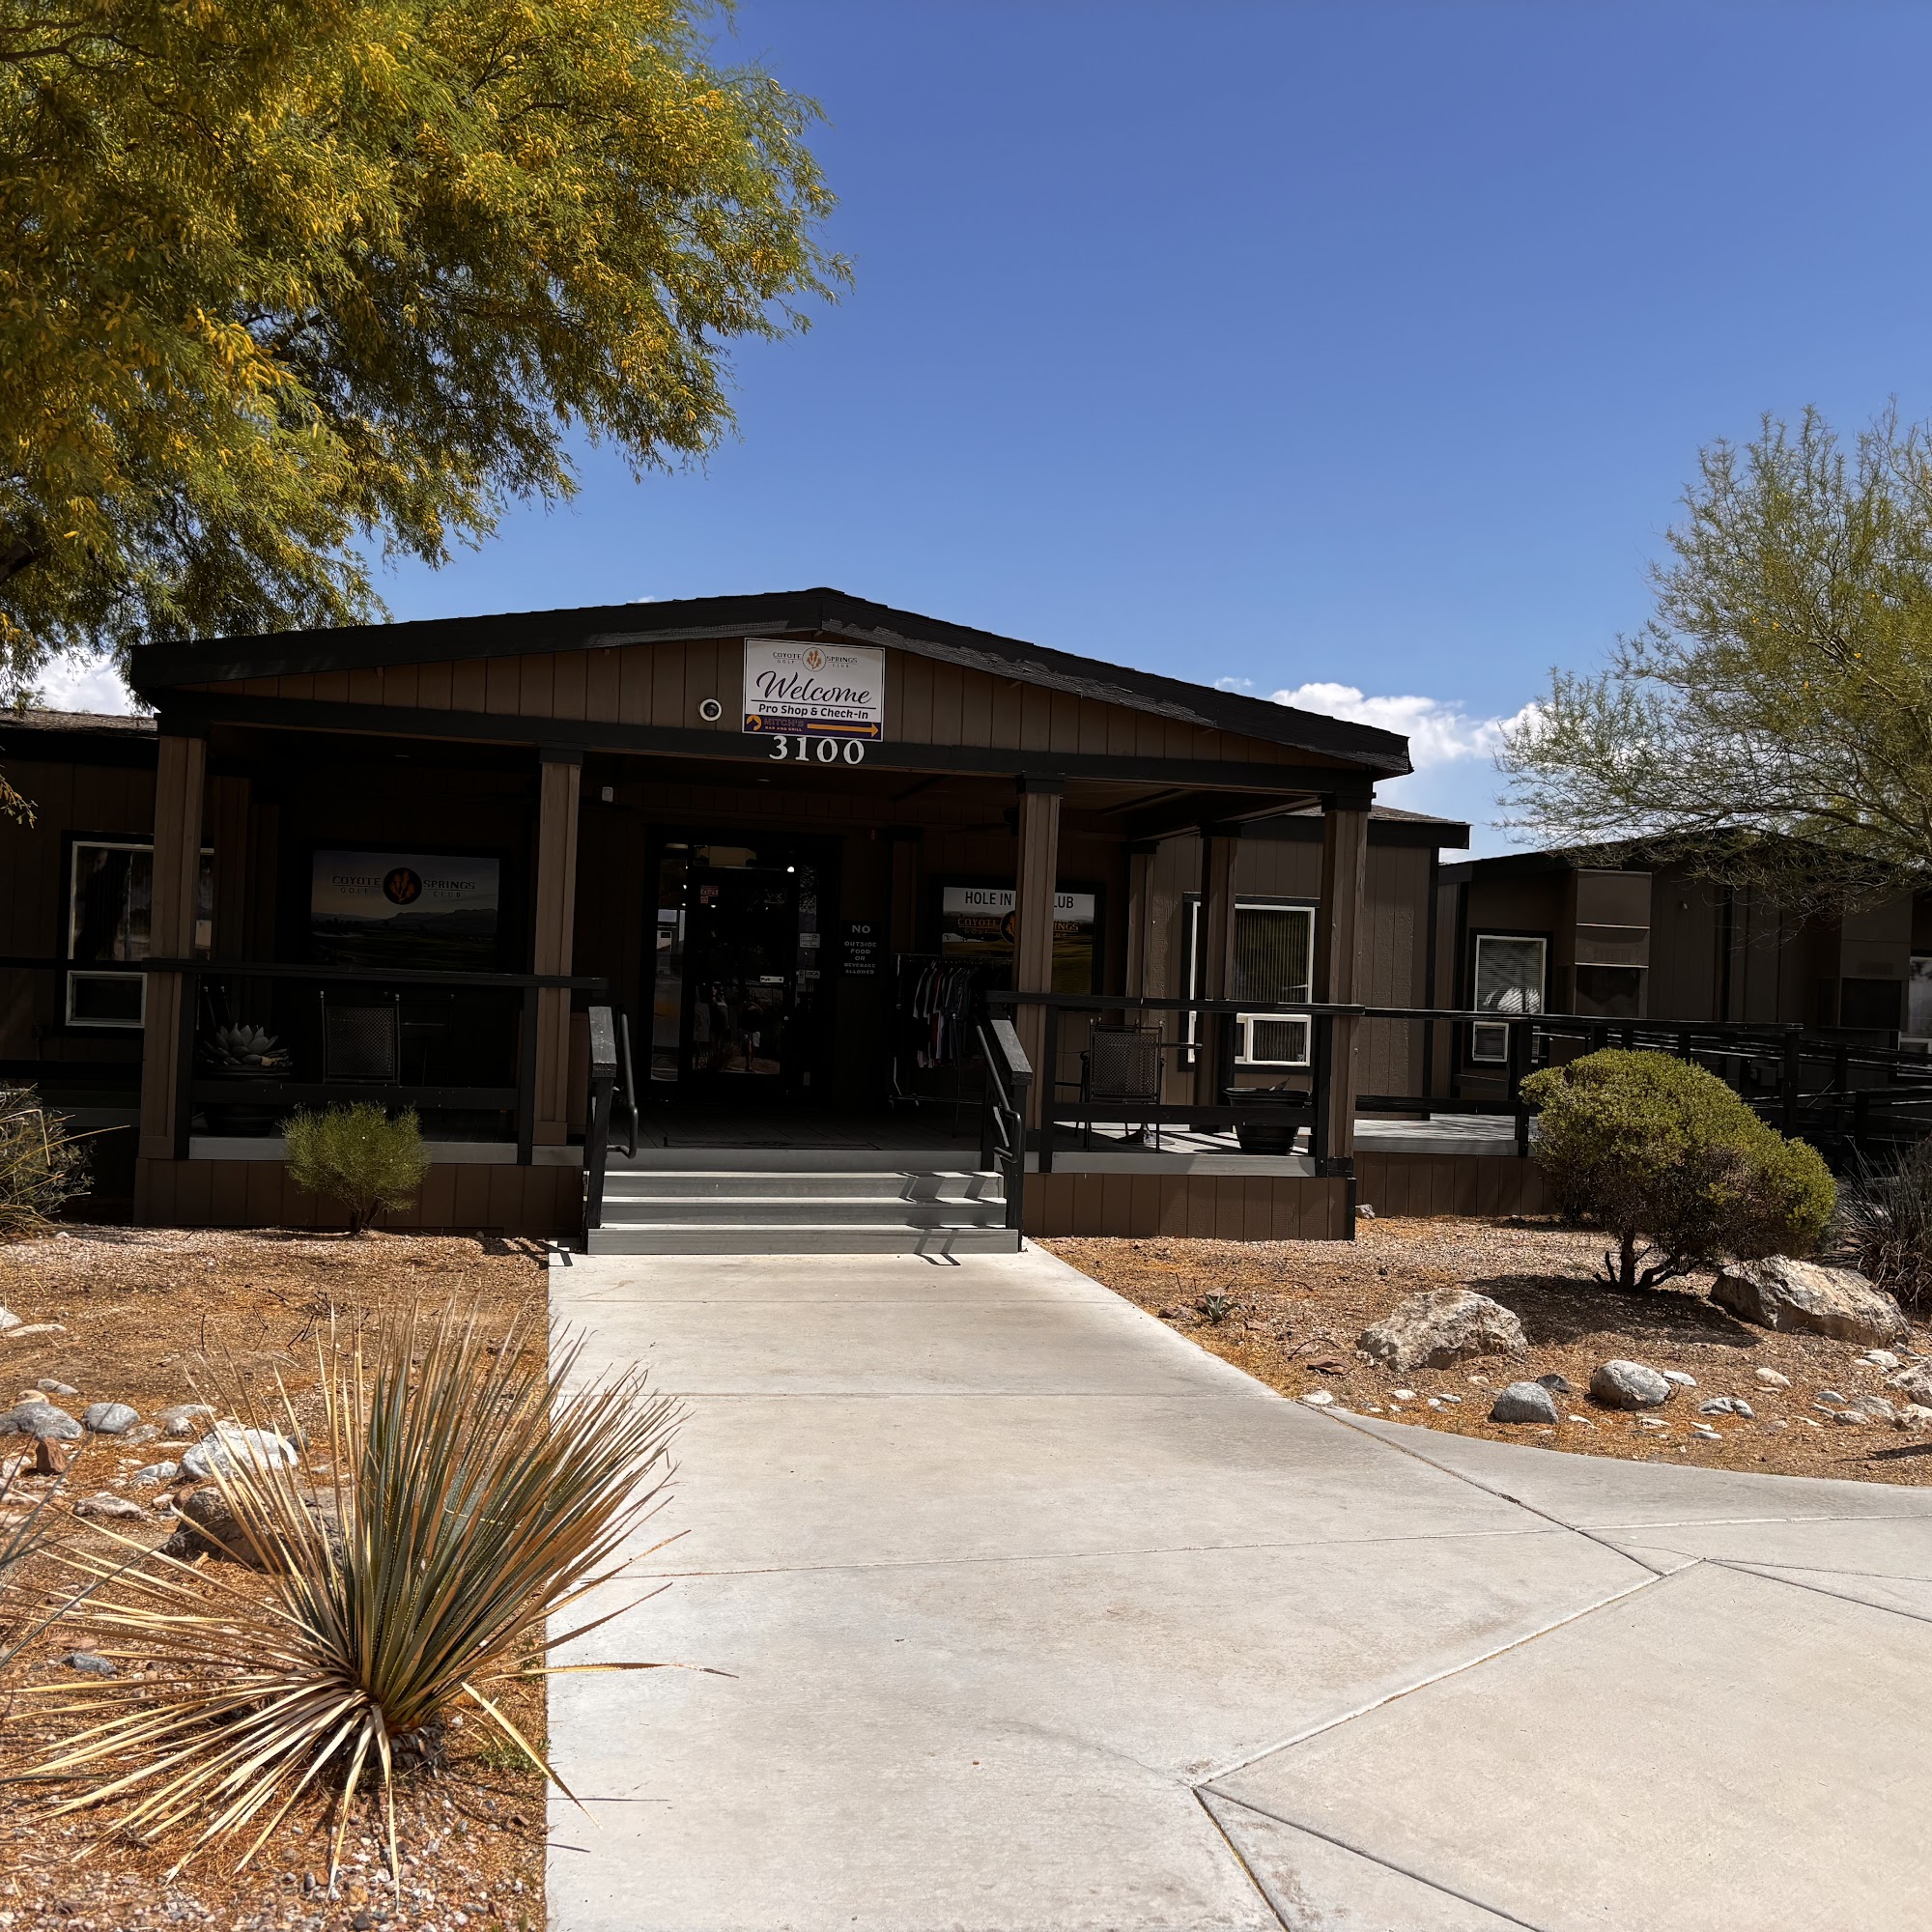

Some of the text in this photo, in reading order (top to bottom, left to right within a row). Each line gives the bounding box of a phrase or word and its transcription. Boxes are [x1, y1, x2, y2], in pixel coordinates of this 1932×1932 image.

[773, 651, 858, 664] COYOTE SPRINGS
[755, 670, 872, 704] Welcome
[758, 703, 868, 719] Pro Shop & Check-In
[763, 717, 805, 726] MITCH'S
[769, 735, 865, 765] 3100
[332, 875, 475, 890] COYOTE SPRINGS
[965, 892, 996, 906] HOLE
[1000, 893, 1012, 906] IN
[851, 924, 871, 934] NO
[957, 918, 1001, 927] COYOTE
